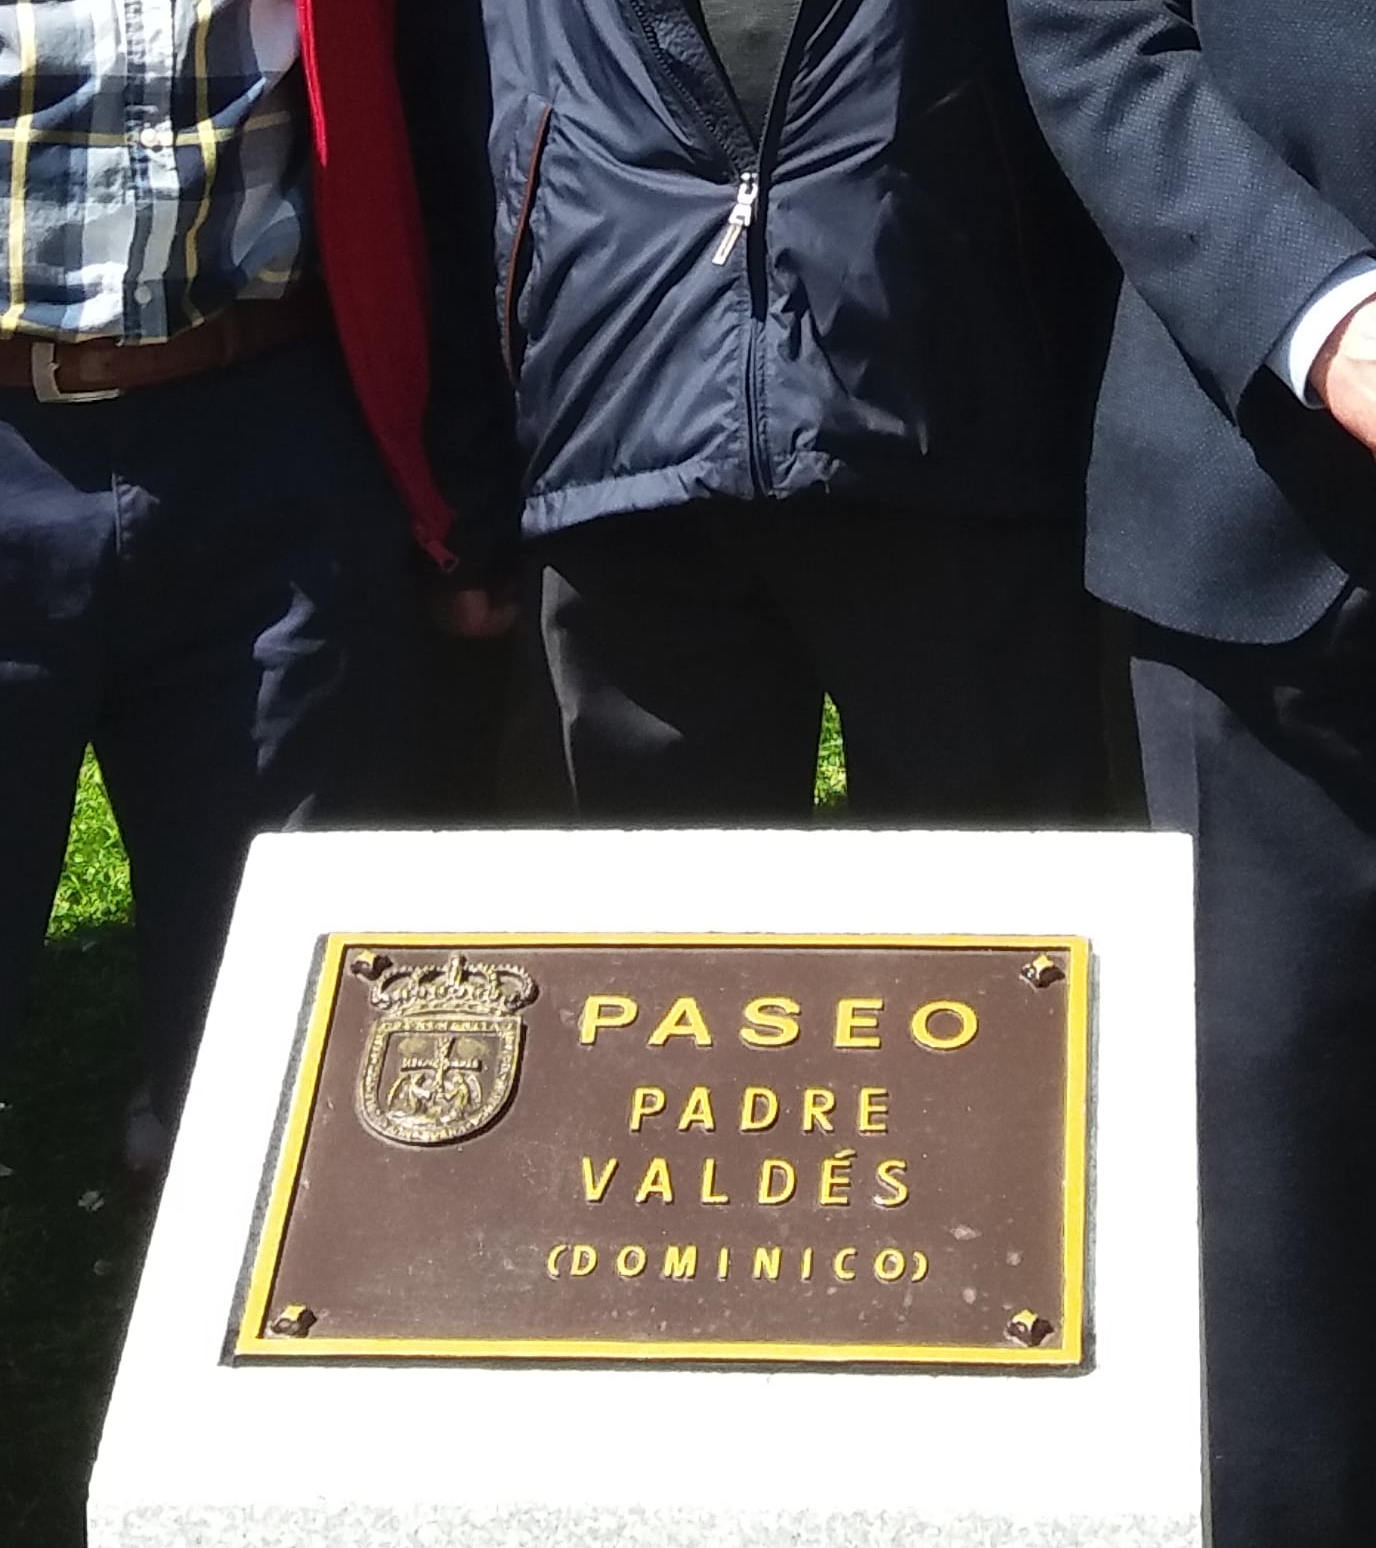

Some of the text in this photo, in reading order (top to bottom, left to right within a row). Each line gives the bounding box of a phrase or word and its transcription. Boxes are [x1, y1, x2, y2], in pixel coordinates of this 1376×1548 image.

[578, 994, 980, 1049] PASEO
[630, 1085, 890, 1133] PADRE
[580, 1151, 910, 1208] VALDÉS
[546, 1244, 929, 1283] (DOMINICO)
